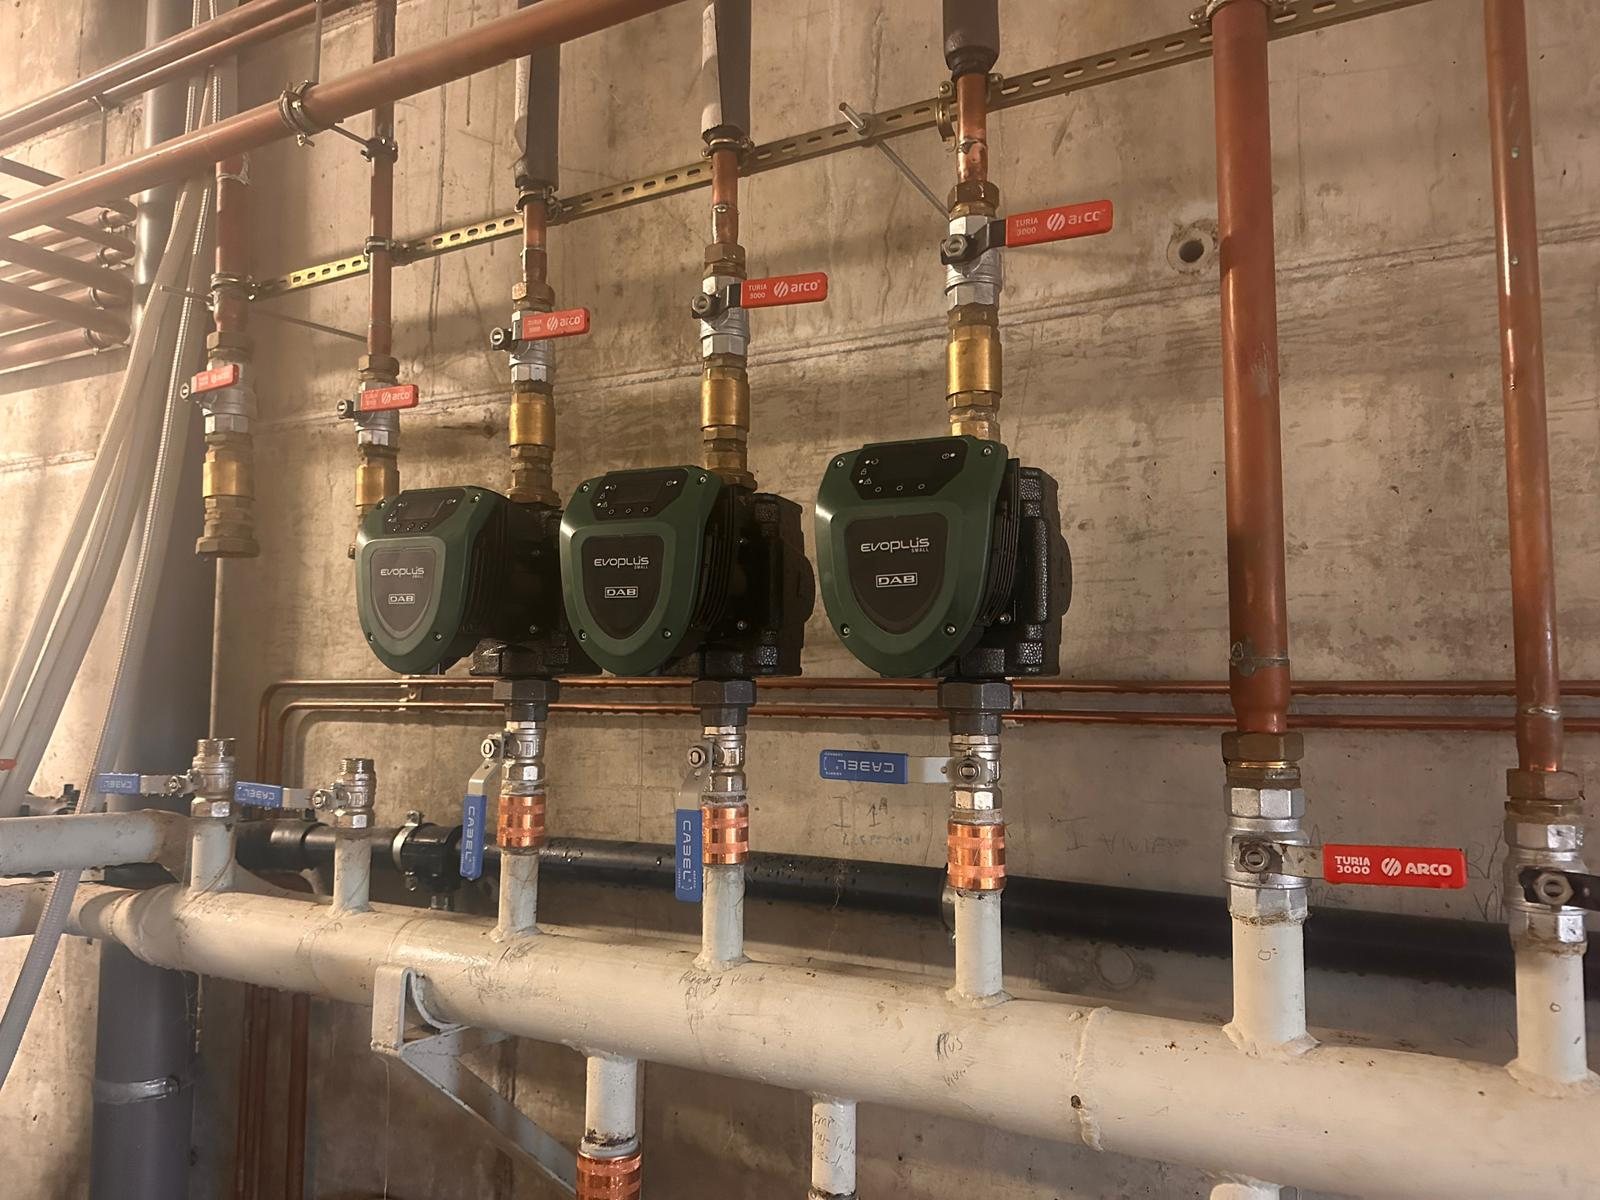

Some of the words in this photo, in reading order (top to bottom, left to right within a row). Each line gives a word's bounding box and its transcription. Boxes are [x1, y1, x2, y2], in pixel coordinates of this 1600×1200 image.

[790, 281, 818, 293] arco
[560, 316, 581, 327] arco
[878, 575, 915, 586] DAB
[606, 588, 637, 596] DAB
[1334, 855, 1371, 867] TURIA
[1336, 865, 1371, 875] 3000
[1405, 862, 1453, 877] ARCO
